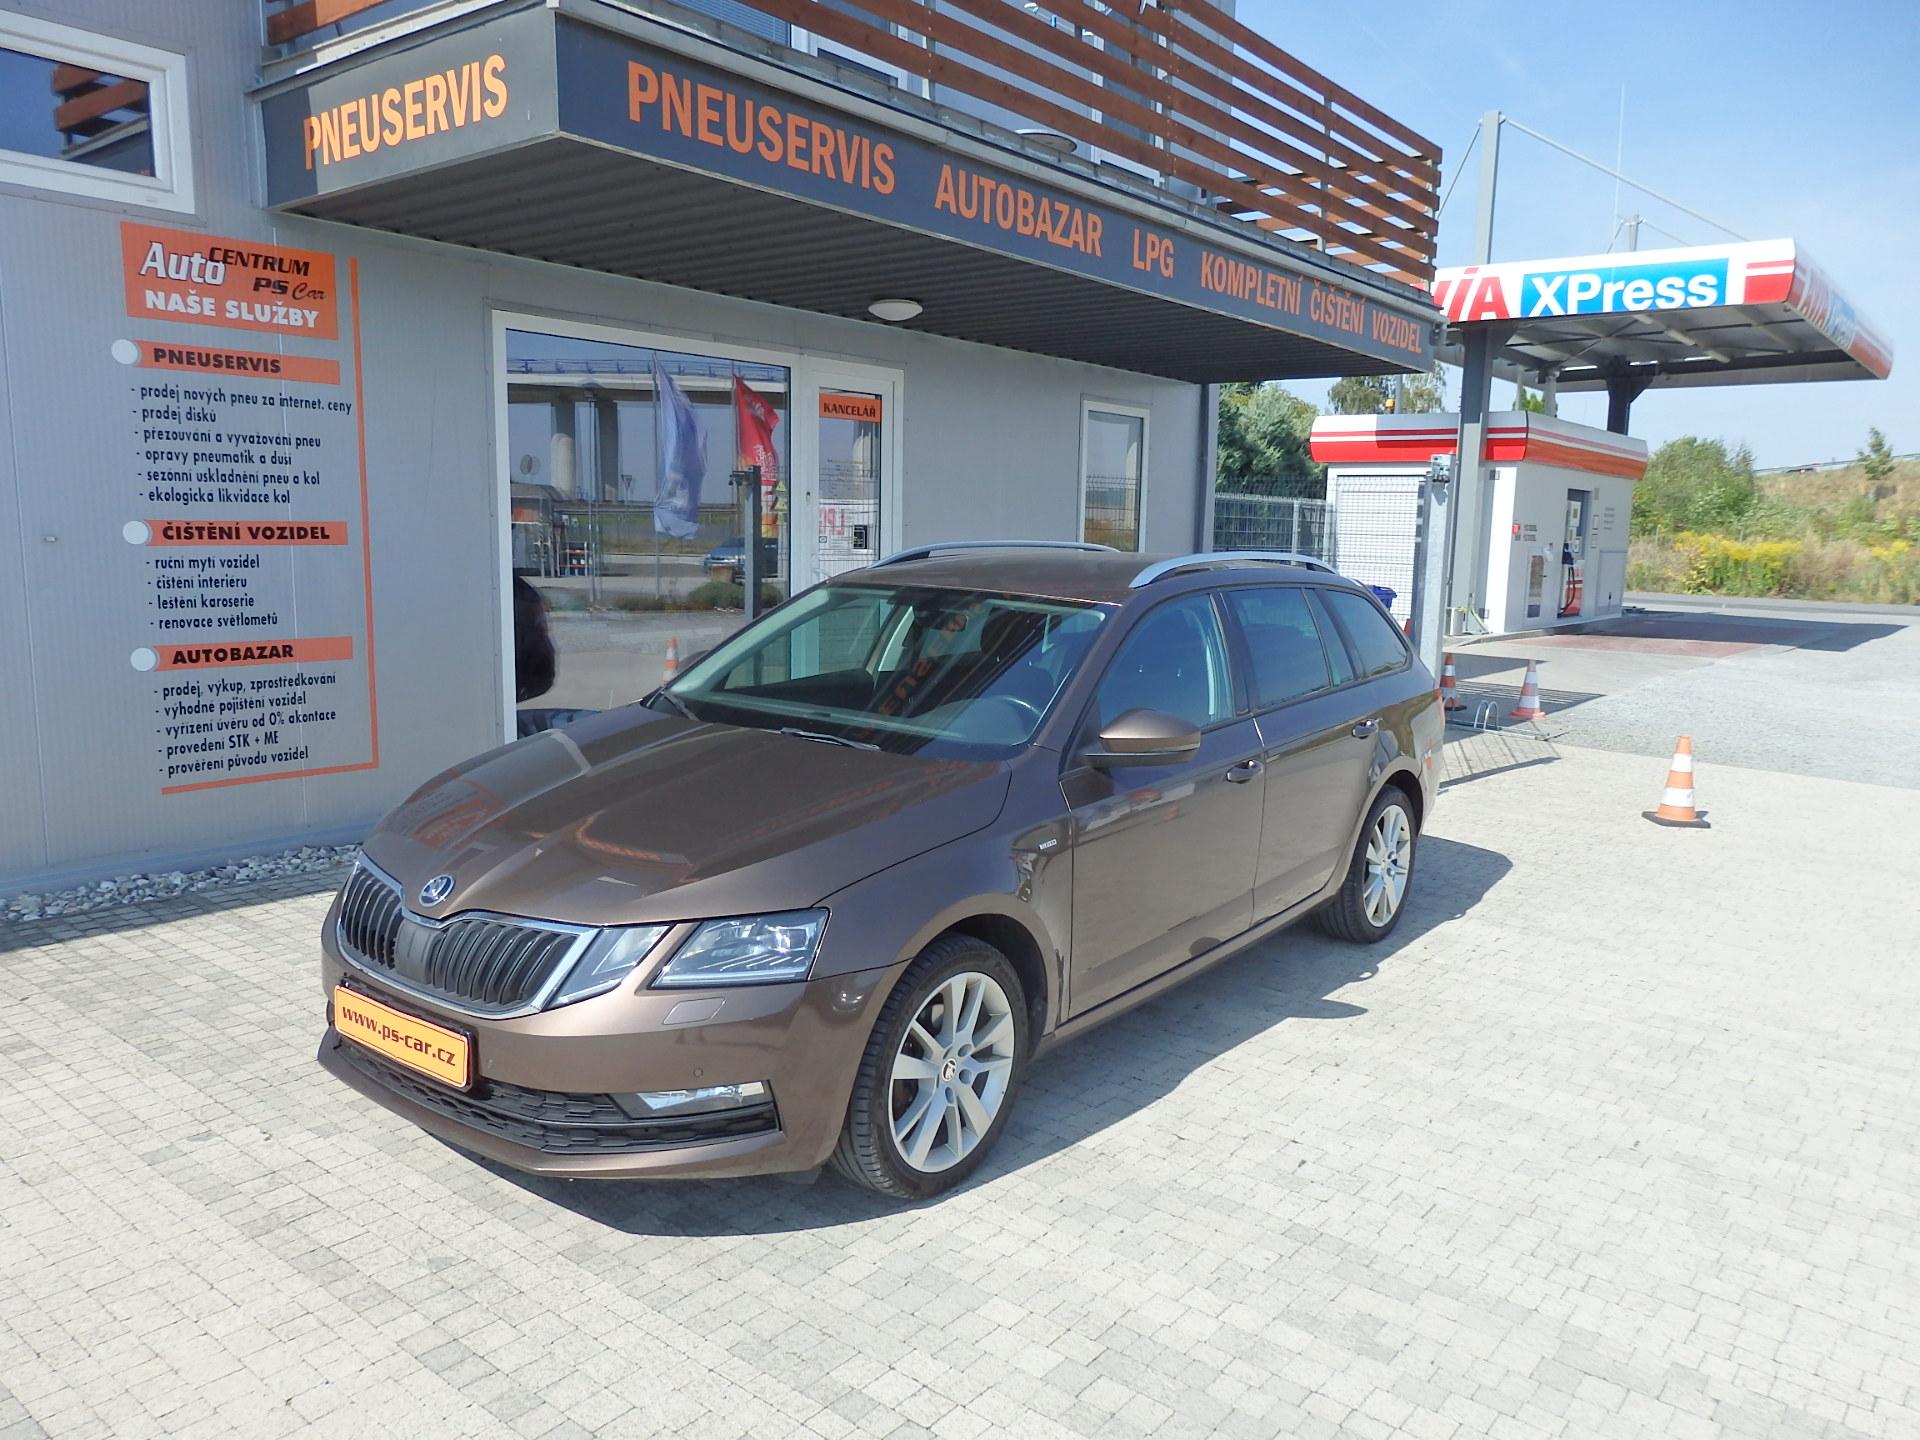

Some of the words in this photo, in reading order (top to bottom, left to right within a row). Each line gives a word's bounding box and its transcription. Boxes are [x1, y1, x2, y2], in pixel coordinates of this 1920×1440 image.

[303, 54, 508, 170] PNEUSERVIS
[628, 61, 896, 194] PNEUSERVIS
[934, 164, 1102, 257] AUTOBAZAR
[1132, 226, 1174, 279] LPG
[1201, 251, 1303, 315] KOMPLETNÍ
[1310, 279, 1366, 335] ČIŠTĚNÍ
[1372, 309, 1422, 353] VOZIDEL
[139, 241, 226, 285] Auto
[209, 247, 310, 276] CENTRUM
[253, 277, 289, 295] PS
[292, 282, 326, 300] Car
[1528, 273, 1718, 317] XPress
[145, 289, 216, 316] NAŠE
[225, 300, 319, 328] SLUŽBY
[154, 348, 280, 373] PNEUSERVIS
[140, 384, 179, 403] prodej
[184, 388, 226, 405] nových
[231, 393, 257, 407] pneu
[262, 395, 275, 406] za
[279, 393, 324, 410] internet.
[328, 401, 352, 415] ceny
[824, 403, 876, 417] KANCELÁŘ
[142, 405, 182, 424] prodej
[186, 408, 216, 422] disků
[144, 427, 211, 442] přezouvání
[216, 432, 222, 443] a
[227, 429, 291, 447] vyvažování
[296, 436, 320, 449] pneu
[146, 450, 188, 465] opravy
[194, 449, 255, 465] pneumatik
[260, 454, 266, 464] a
[147, 468, 192, 482] sezónní
[197, 468, 259, 483] uskladnění
[263, 473, 289, 486] pneu
[293, 474, 299, 484] a
[304, 471, 320, 485] kol
[148, 487, 214, 505] ekologická
[218, 488, 269, 503] likvidace
[274, 489, 290, 503] kol
[162, 522, 240, 540] ČIŠTĚNÍ
[248, 527, 329, 540] VOZIDEL
[155, 557, 184, 569] ruční
[220, 554, 260, 569] vozidel
[156, 575, 194, 589] čištění
[198, 574, 247, 588] interiéru
[158, 595, 197, 610] leštění
[201, 594, 255, 608] karoserie
[159, 616, 213, 629] renovace
[218, 612, 278, 627] světlometů
[172, 645, 294, 664] AUTOBAZAR
[208, 678, 246, 694] výkup,
[250, 672, 336, 690] zprostředkování
[164, 700, 215, 719] výhodné
[219, 695, 265, 714] pojištění
[269, 692, 306, 707] vozidel
[166, 719, 213, 739] vyřízení
[218, 717, 248, 731] úvěru
[252, 713, 265, 727] od
[269, 712, 284, 725] 0%
[289, 710, 336, 723] akontace
[167, 737, 225, 759] provedení
[228, 734, 249, 749] STK
[264, 731, 278, 745] ME
[168, 758, 224, 778] prověření
[228, 749, 267, 771] původu
[272, 746, 309, 762] vozidel
[342, 1006, 456, 1066] www.ps-car.cz
